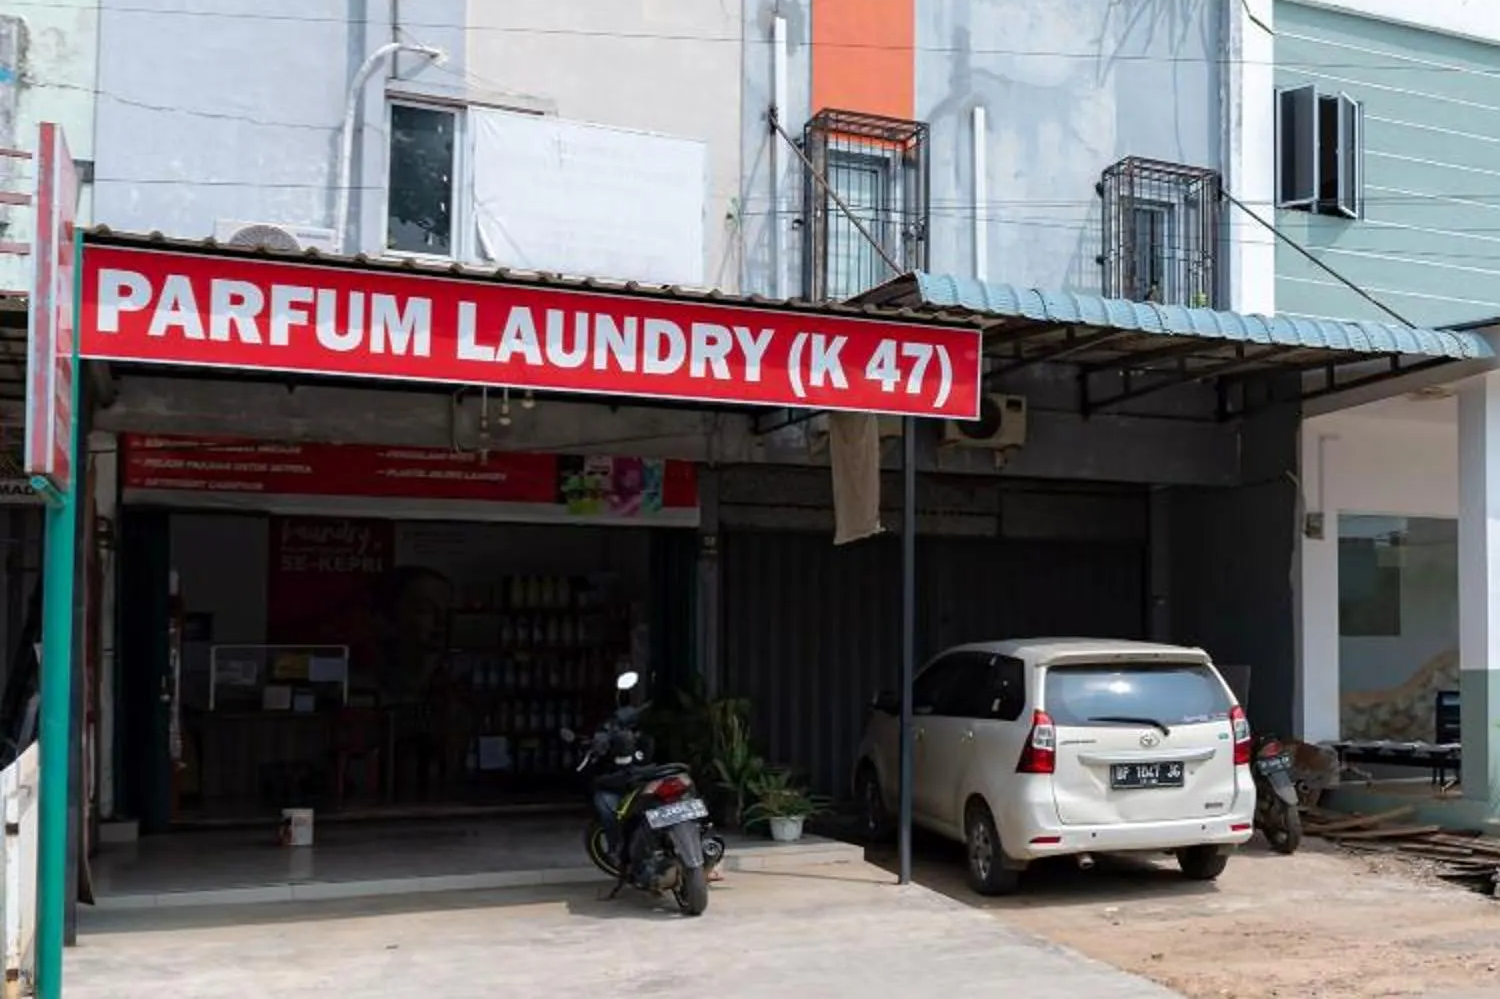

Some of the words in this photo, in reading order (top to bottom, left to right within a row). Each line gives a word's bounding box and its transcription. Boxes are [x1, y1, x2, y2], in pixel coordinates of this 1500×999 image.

[96, 268, 432, 358] PARFUM
[456, 301, 776, 382] LAUNDRY
[787, 331, 849, 398] (K
[864, 338, 953, 408] 47)
